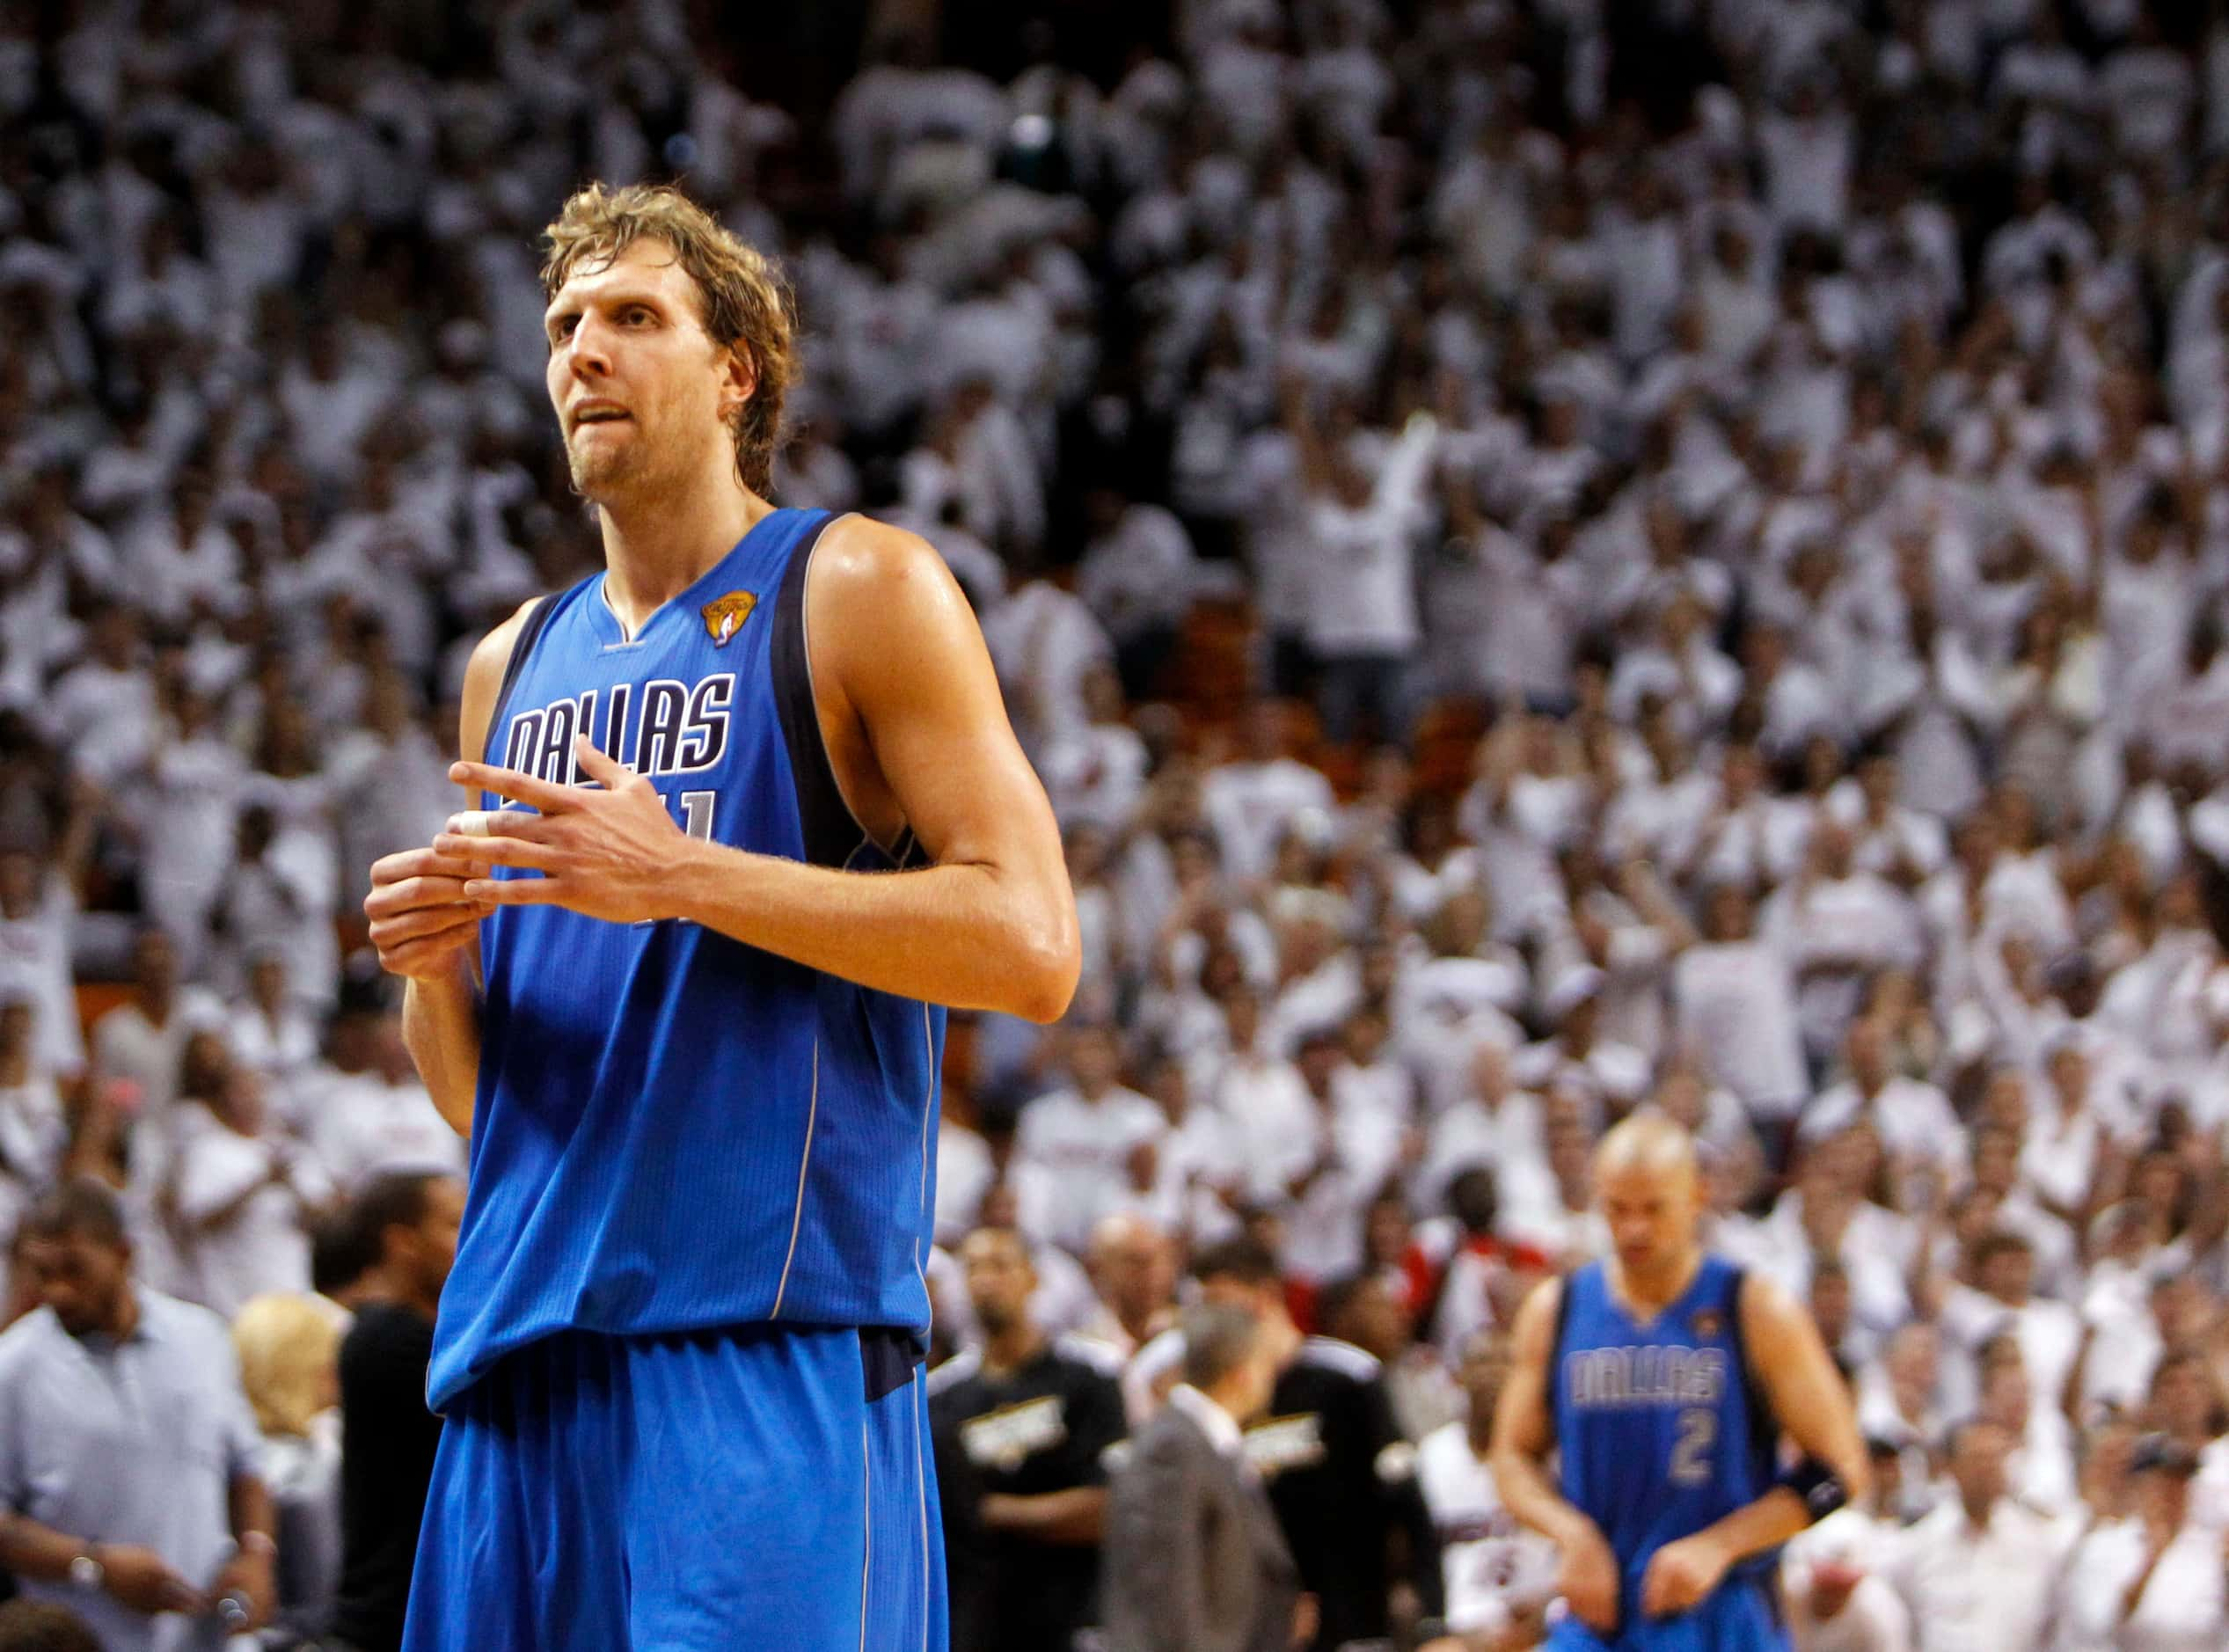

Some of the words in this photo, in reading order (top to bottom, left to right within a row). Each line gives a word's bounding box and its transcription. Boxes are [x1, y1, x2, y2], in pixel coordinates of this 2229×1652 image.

[500, 673, 735, 809] DALLAS
[1563, 1344, 1728, 1407] DALLAS
[1670, 1408, 1717, 1482] 2
